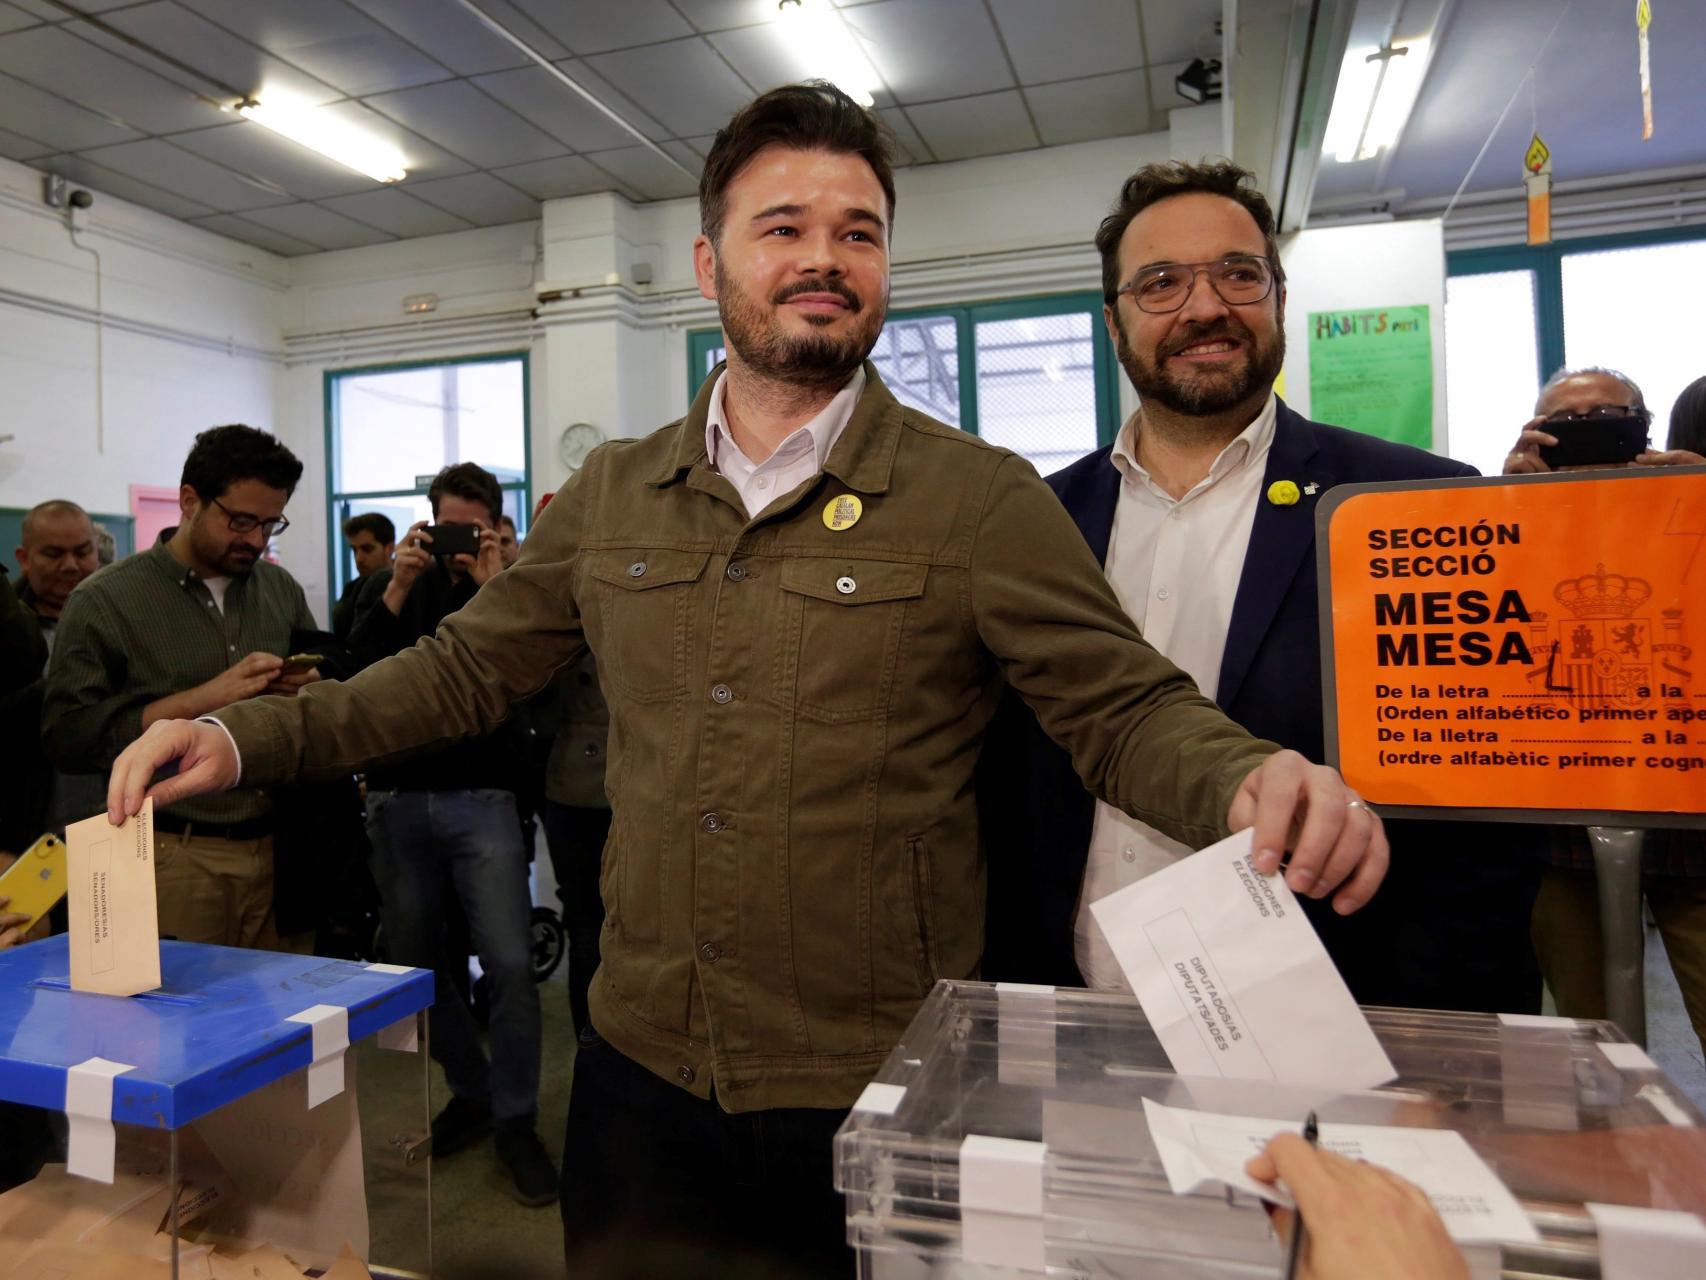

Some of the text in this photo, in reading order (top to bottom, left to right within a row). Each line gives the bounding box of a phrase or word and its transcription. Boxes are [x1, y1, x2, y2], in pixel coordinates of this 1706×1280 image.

[1368, 519, 1520, 551] SECCIÓN
[1369, 549, 1496, 579] SECCIÓ
[1375, 590, 1532, 626] MESA
[1377, 631, 1534, 666] MESA
[1375, 683, 1683, 698] De la letra a la
[1376, 705, 1448, 722] (Orden
[1456, 705, 1570, 720] alfabético
[1579, 705, 1658, 723] primer
[1378, 727, 1688, 744] De la lletra a la
[1378, 750, 1706, 772] (ordre alfabètic primer cogn
[1232, 860, 1270, 917] ELECCIONS
[1174, 962, 1229, 1051] DIPUTATS/ADES
[1190, 956, 1242, 1041] DIPUTADOS/AS
